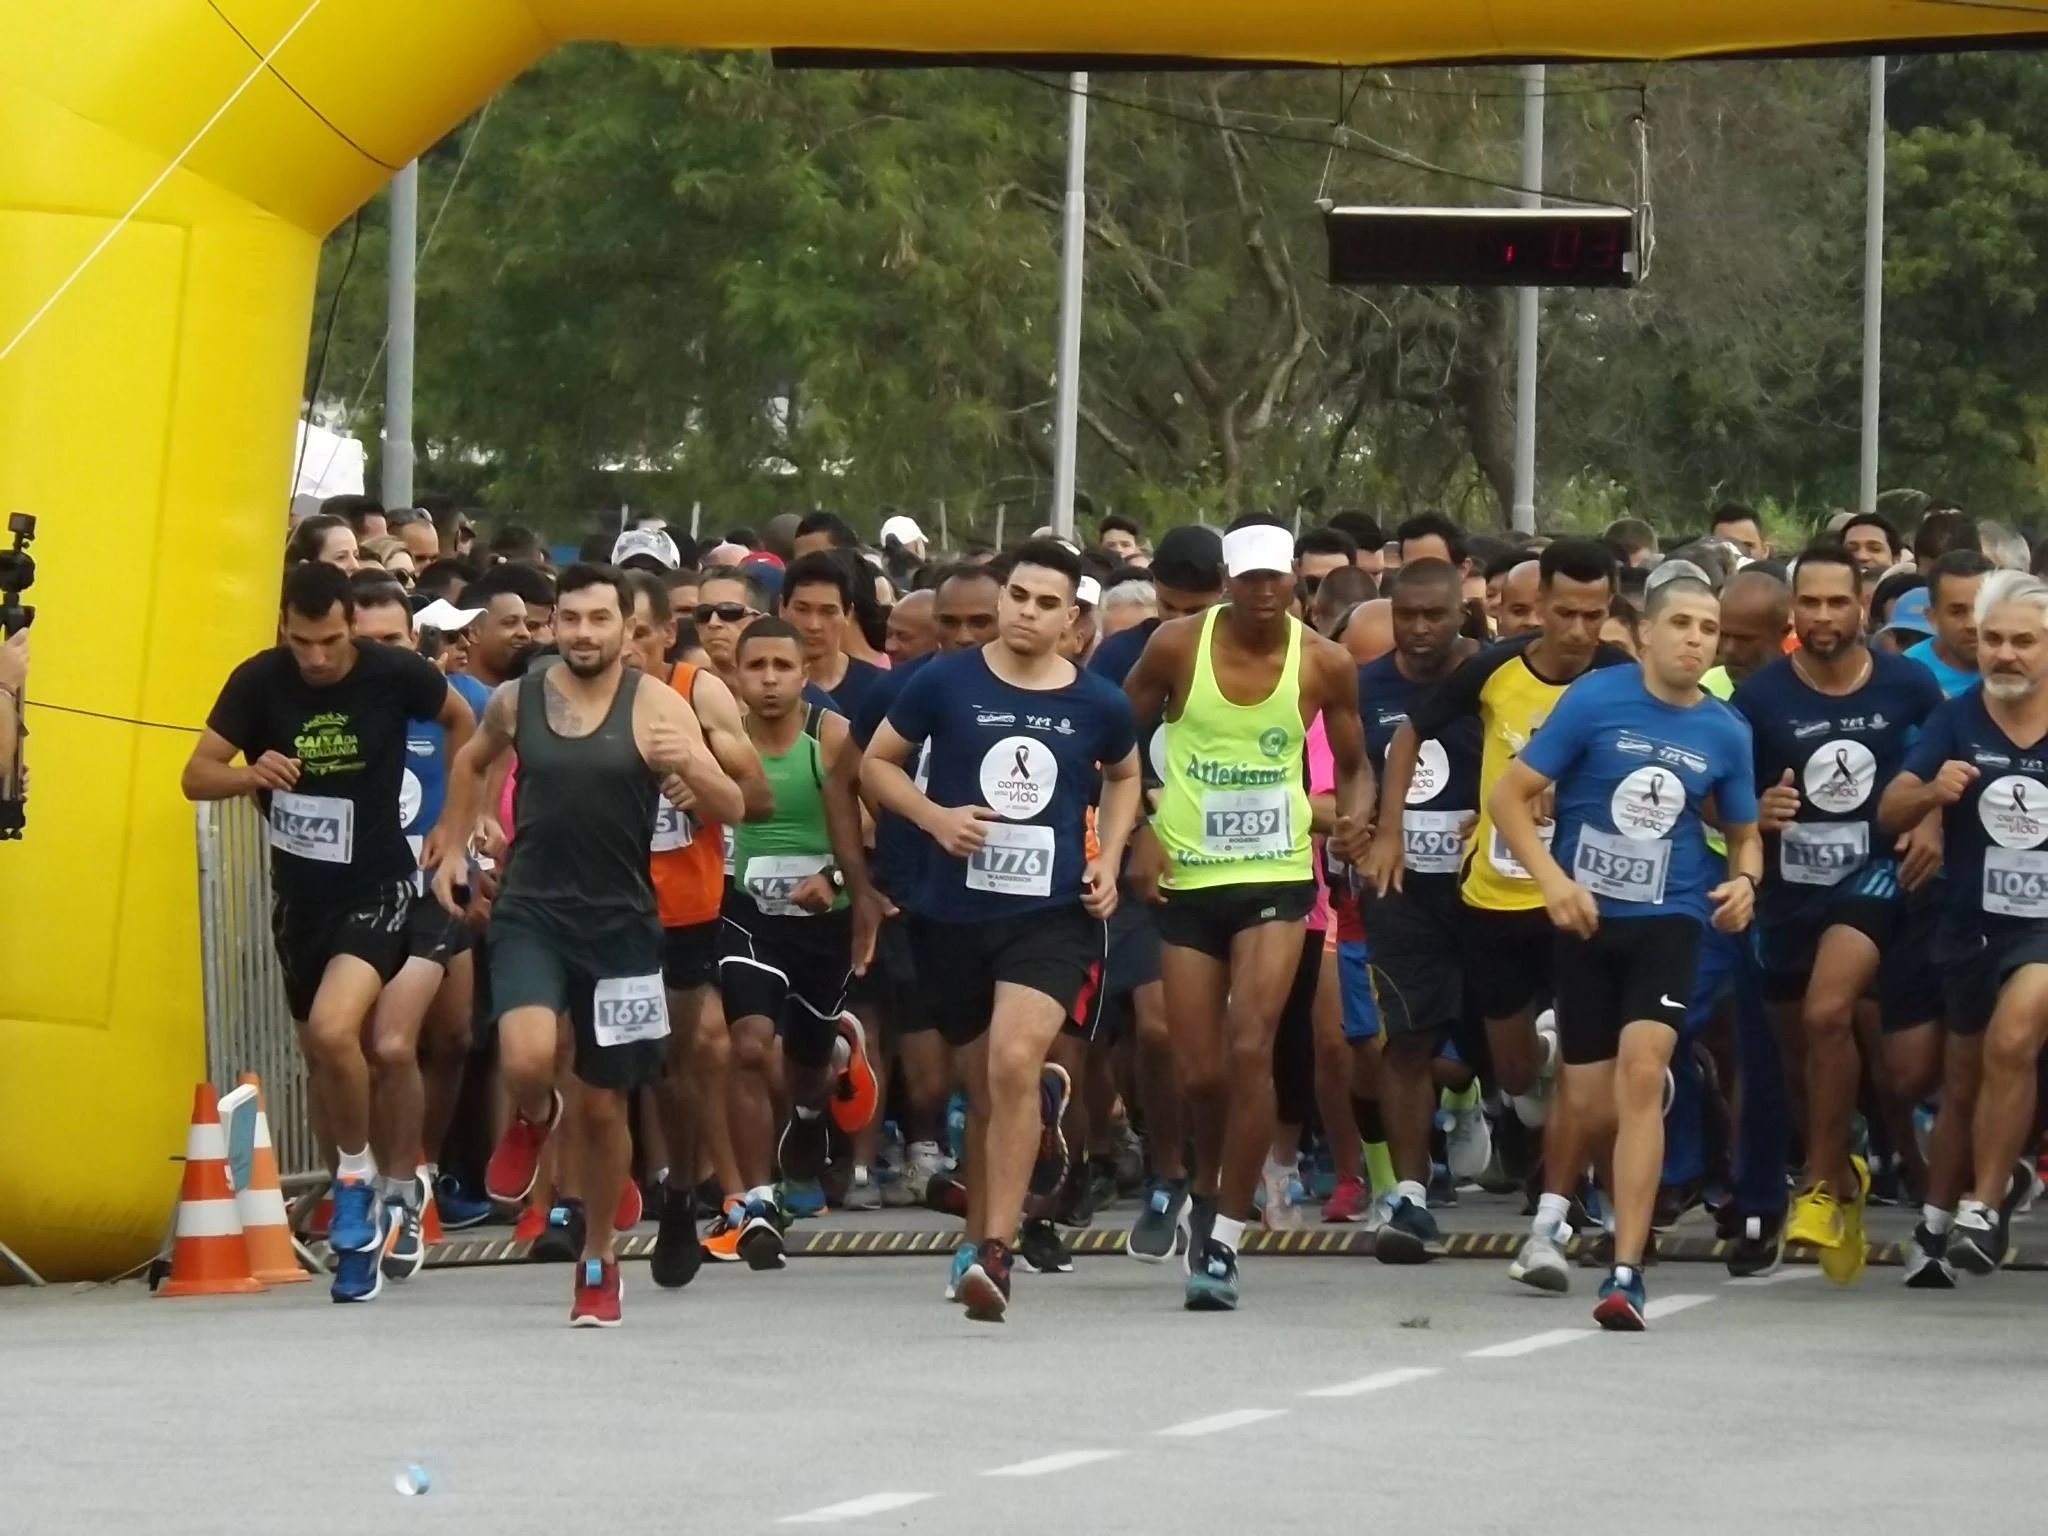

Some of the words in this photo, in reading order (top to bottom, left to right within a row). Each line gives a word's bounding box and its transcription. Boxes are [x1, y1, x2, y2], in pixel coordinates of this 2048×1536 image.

[294, 734, 343, 749] CAIXA
[276, 809, 335, 843] 1644
[1212, 810, 1276, 836] 1289
[982, 846, 1041, 875] 1776
[1586, 847, 1649, 883] 1398
[604, 999, 661, 1025] 1693
